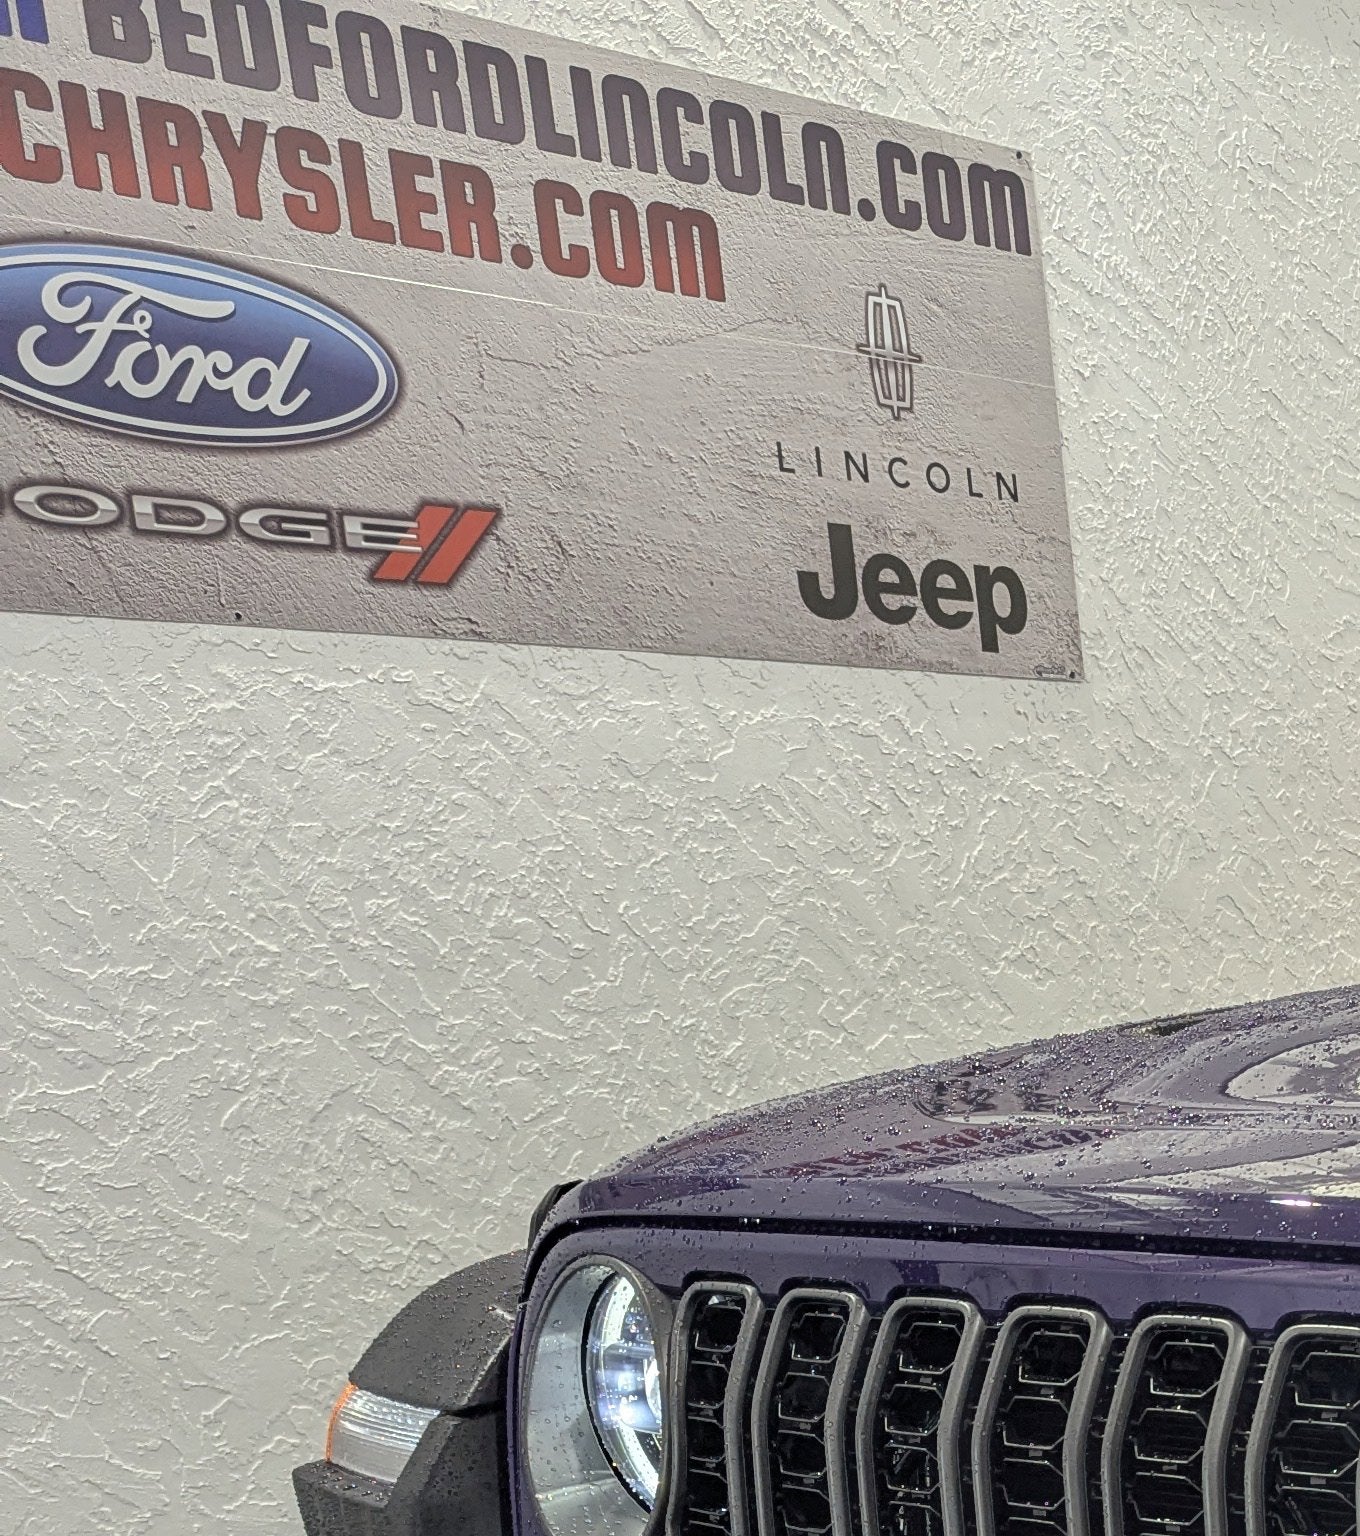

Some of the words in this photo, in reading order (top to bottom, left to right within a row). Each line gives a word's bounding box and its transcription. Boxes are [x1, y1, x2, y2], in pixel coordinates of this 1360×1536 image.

[0, 67, 726, 301] CHRYSLER.COM
[84, 0, 1032, 256] BEDFORDLINCOLN.COM
[17, 271, 311, 416] Ford
[13, 484, 424, 553] ODGE
[776, 441, 1019, 502] LINCOLN
[797, 522, 1028, 653] Jeep
